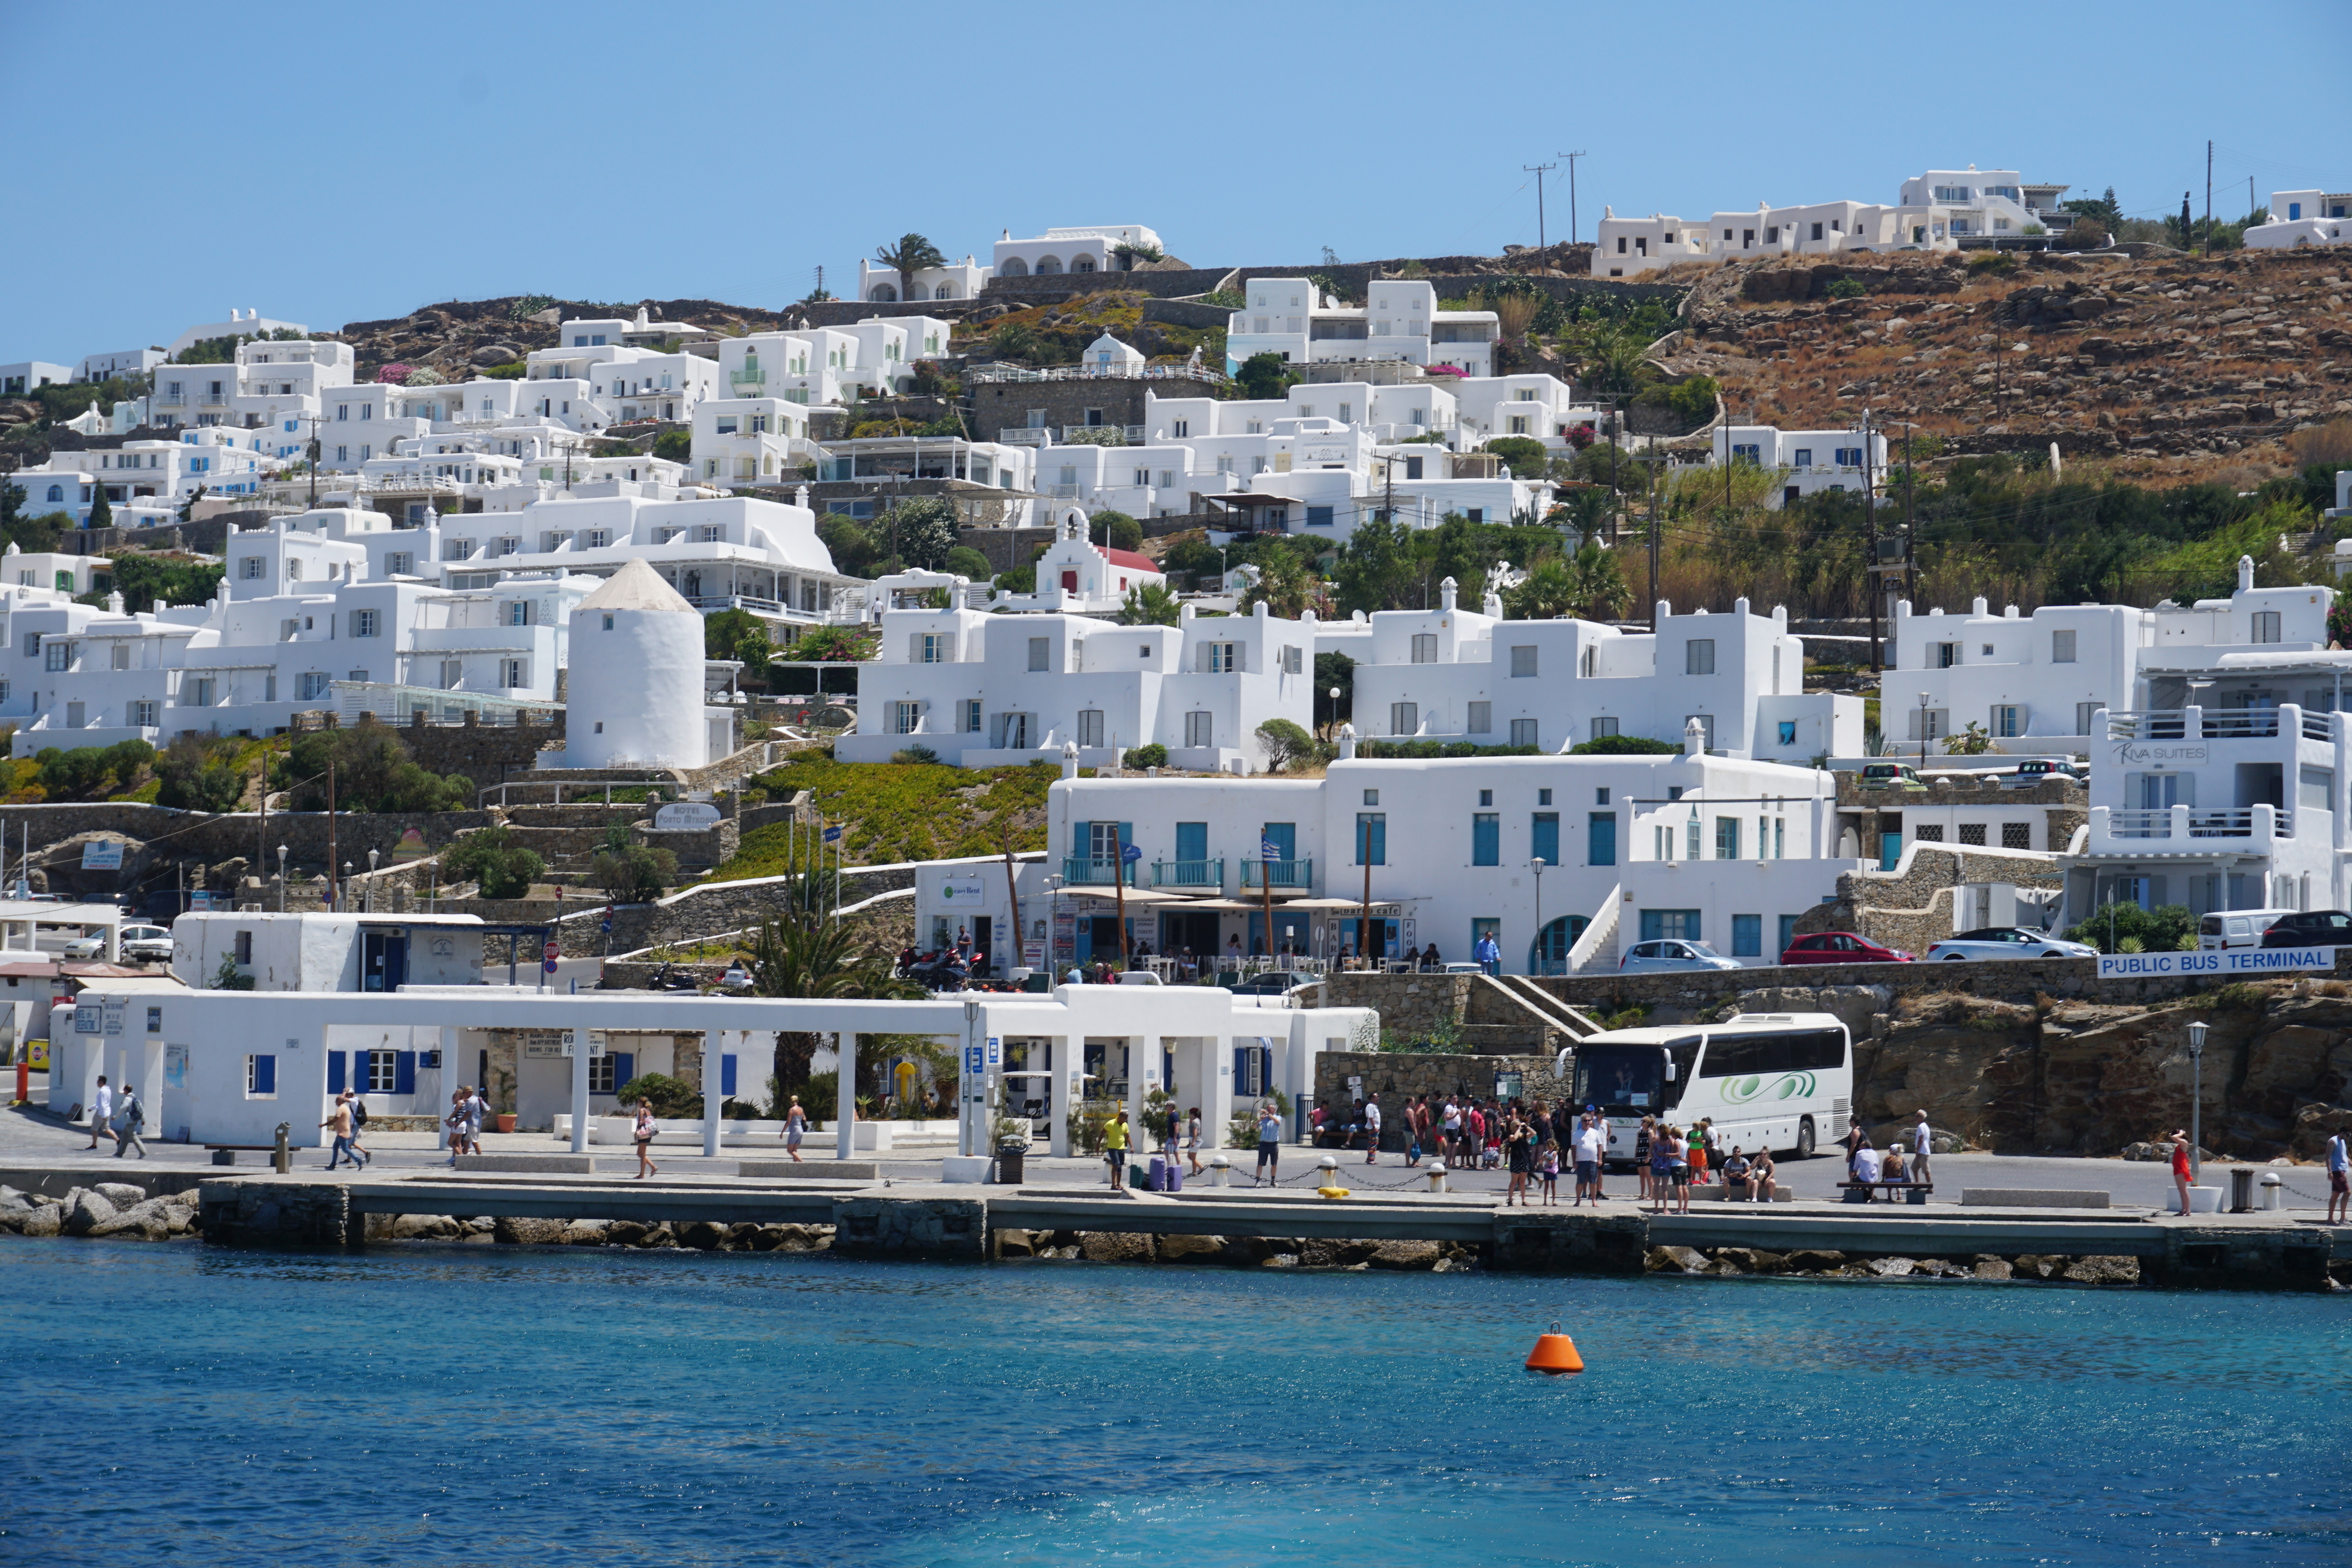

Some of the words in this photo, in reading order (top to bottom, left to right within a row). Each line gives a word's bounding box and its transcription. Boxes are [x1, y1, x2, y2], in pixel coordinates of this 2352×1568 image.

[2113, 743, 2150, 764] RIVA
[2154, 748, 2205, 759] SUITES
[674, 806, 700, 815] HOTEL
[659, 814, 681, 824] PORTO
[1377, 906, 1398, 914] cafe
[544, 947, 559, 955] STOP
[2103, 957, 2171, 974] PUBLIC
[2181, 955, 2219, 970] BUS
[2228, 951, 2328, 969] TERMINAL
